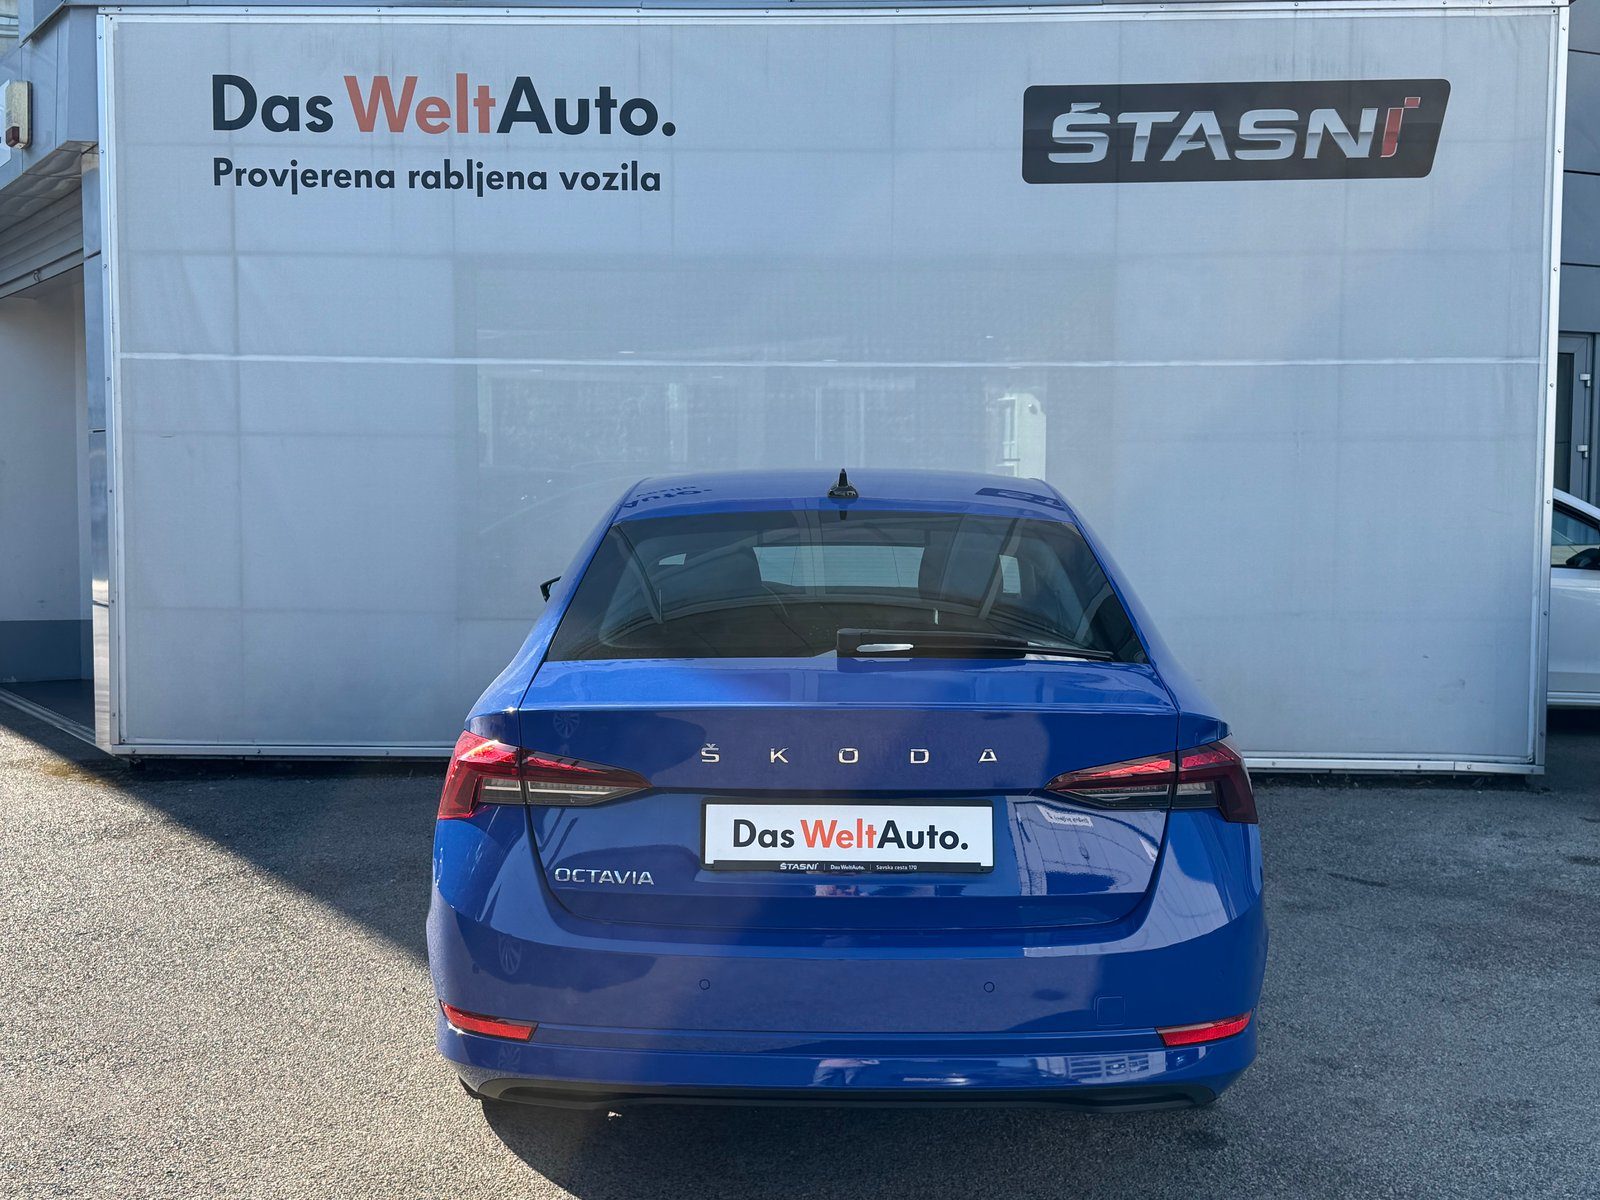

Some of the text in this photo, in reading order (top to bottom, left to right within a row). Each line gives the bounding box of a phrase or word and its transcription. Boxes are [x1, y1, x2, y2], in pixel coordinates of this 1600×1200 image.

[211, 72, 677, 137] Das WeltAuto.
[212, 157, 662, 197] Provjerena rabljena vozila
[700, 742, 998, 764] ŠKODA
[732, 817, 969, 851] Das WeltAuto.
[554, 867, 655, 885] OCTAVIA
